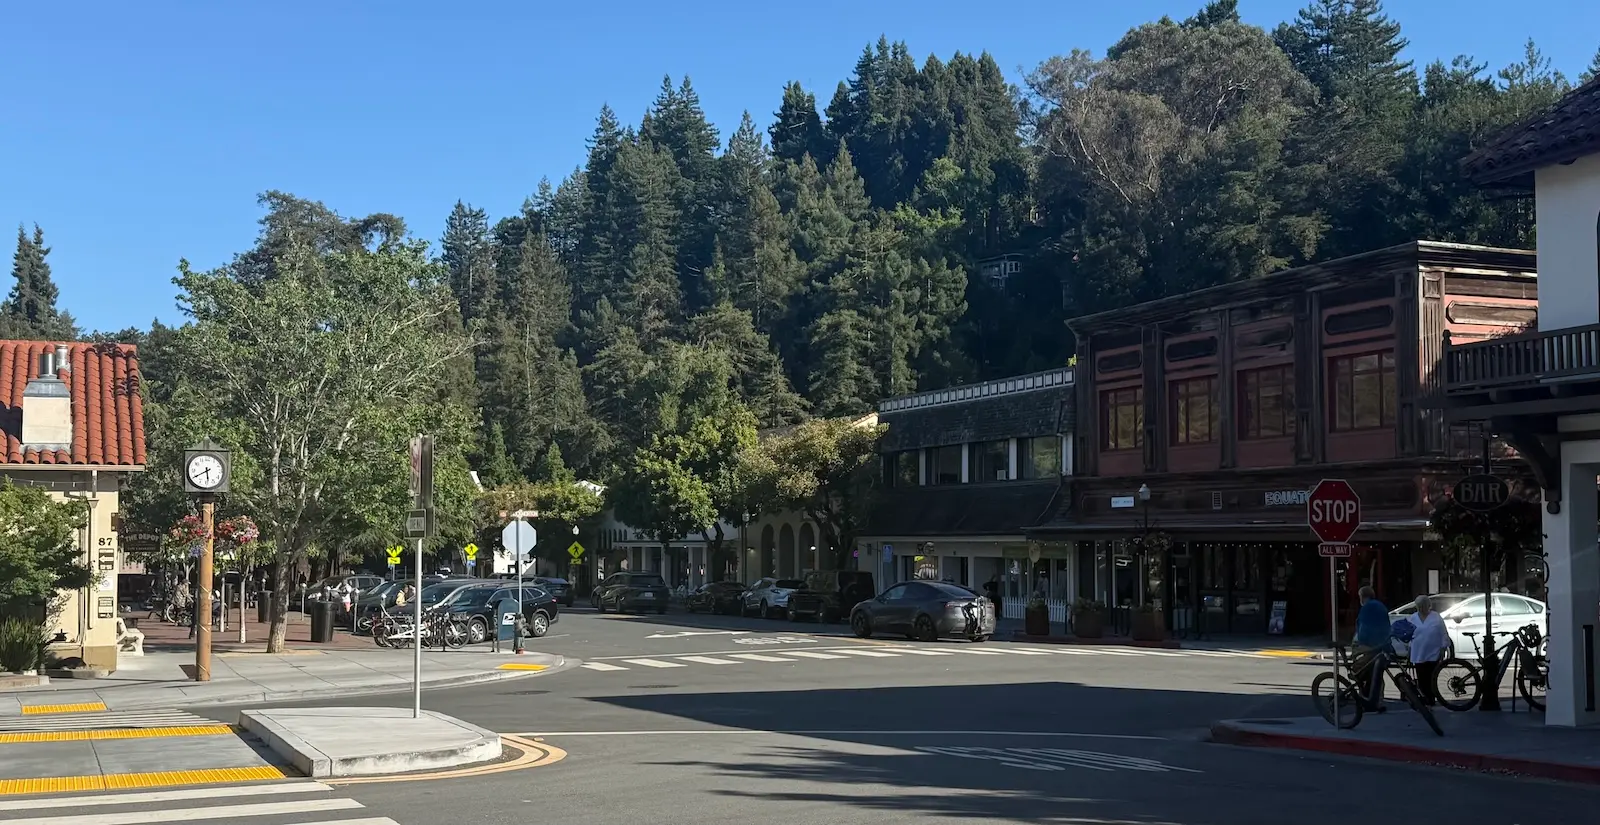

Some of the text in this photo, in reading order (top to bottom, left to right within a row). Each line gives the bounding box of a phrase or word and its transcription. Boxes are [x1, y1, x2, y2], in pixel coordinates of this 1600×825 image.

[1461, 483, 1501, 503] BAR
[1312, 499, 1357, 523] STOP
[98, 537, 112, 546] 87
[125, 533, 160, 542] THE DEPOT
[1322, 546, 1348, 554] ALL WAY
